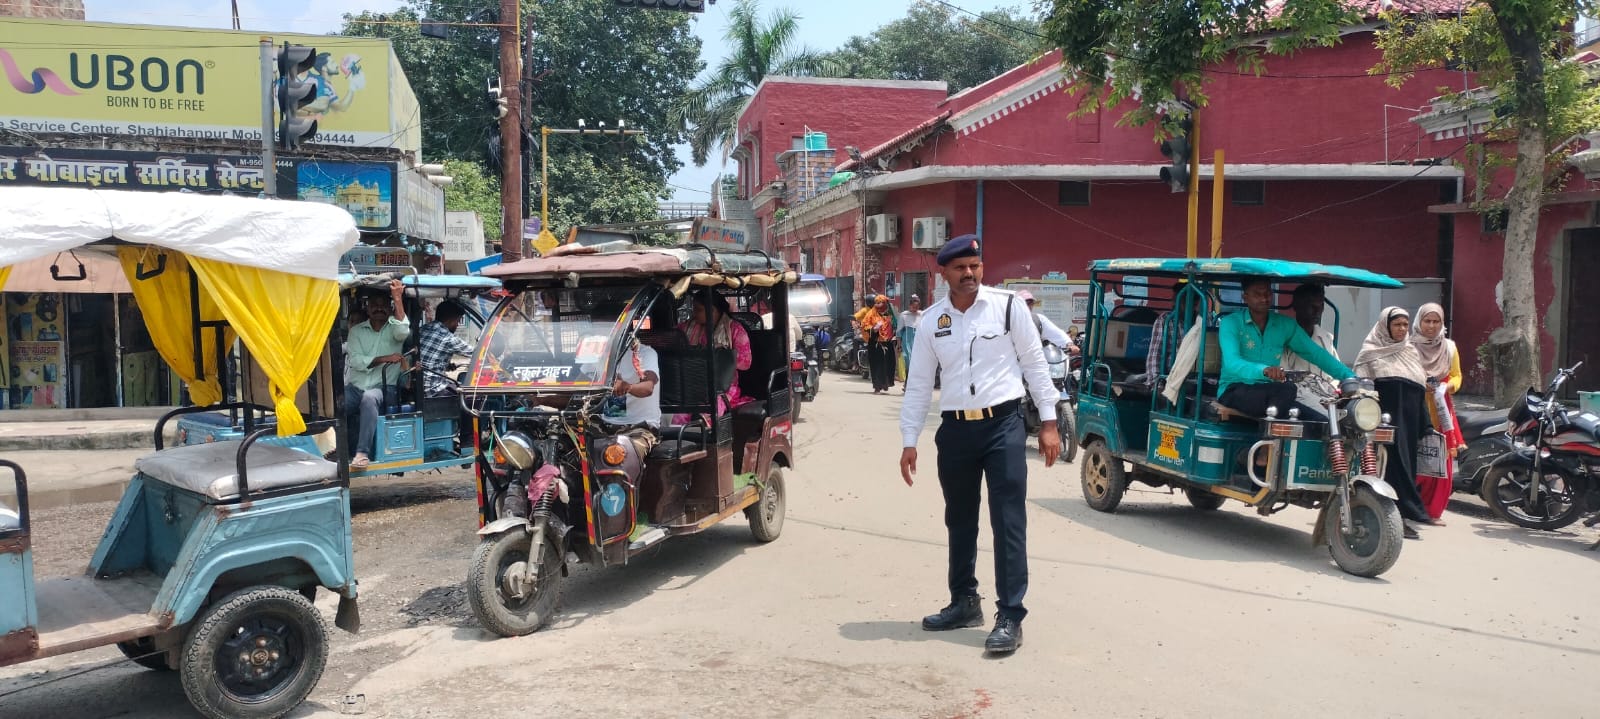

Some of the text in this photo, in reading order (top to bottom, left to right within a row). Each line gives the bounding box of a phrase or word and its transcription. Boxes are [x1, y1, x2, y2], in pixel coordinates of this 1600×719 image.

[107, 95, 205, 111] BORN TO BE FREE
[9, 119, 66, 132] Service
[25, 153, 129, 186] मोबाइल
[136, 158, 209, 187] सर्विस
[216, 159, 264, 189] सेन्ट
[609, 495, 620, 513] 7
